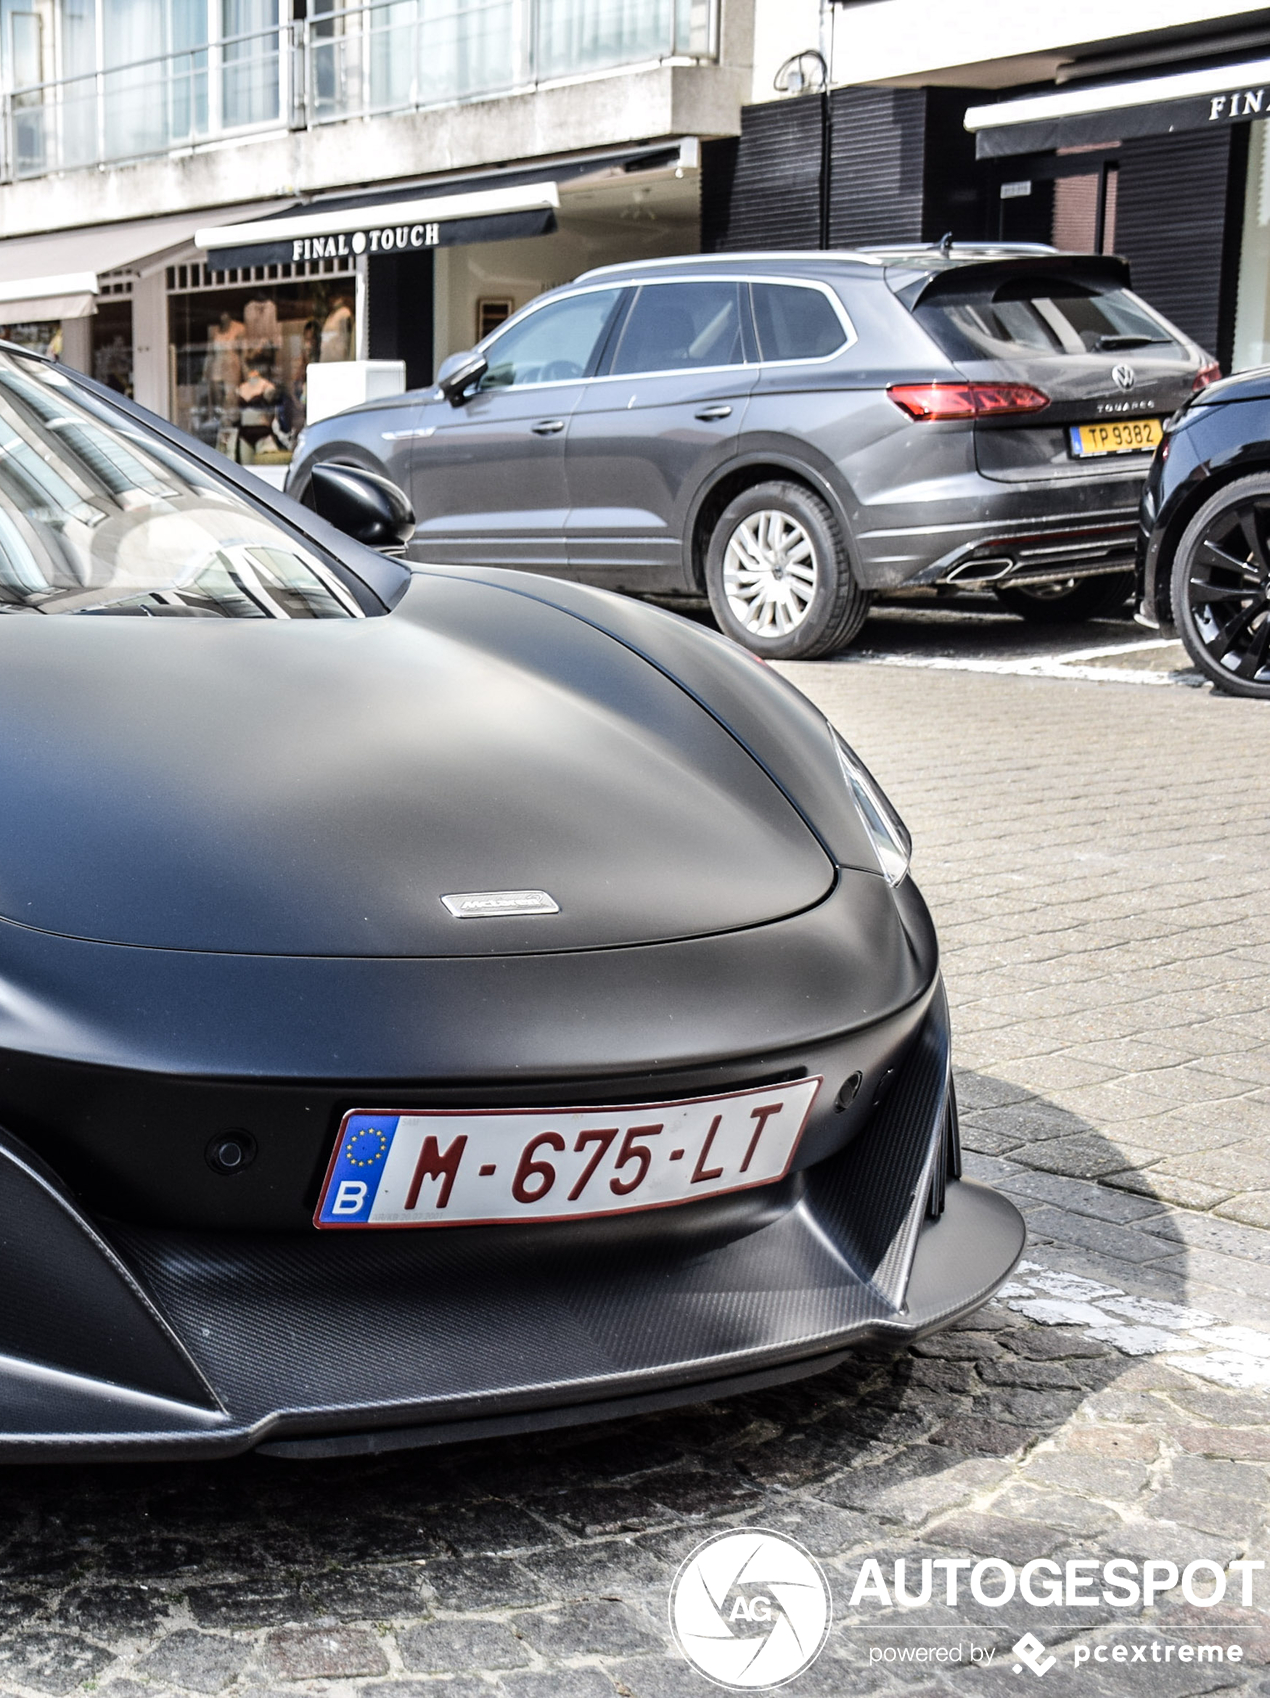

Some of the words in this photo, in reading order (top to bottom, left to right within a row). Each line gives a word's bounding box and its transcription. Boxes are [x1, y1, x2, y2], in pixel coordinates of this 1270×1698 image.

[292, 234, 349, 261] FINAL
[368, 222, 440, 251] TOUCH
[1088, 427, 1109, 448] TP
[1112, 423, 1154, 445] 9382
[462, 898, 541, 910] McLaren
[404, 1102, 784, 1210] M-675-LT
[331, 1180, 368, 1215] B
